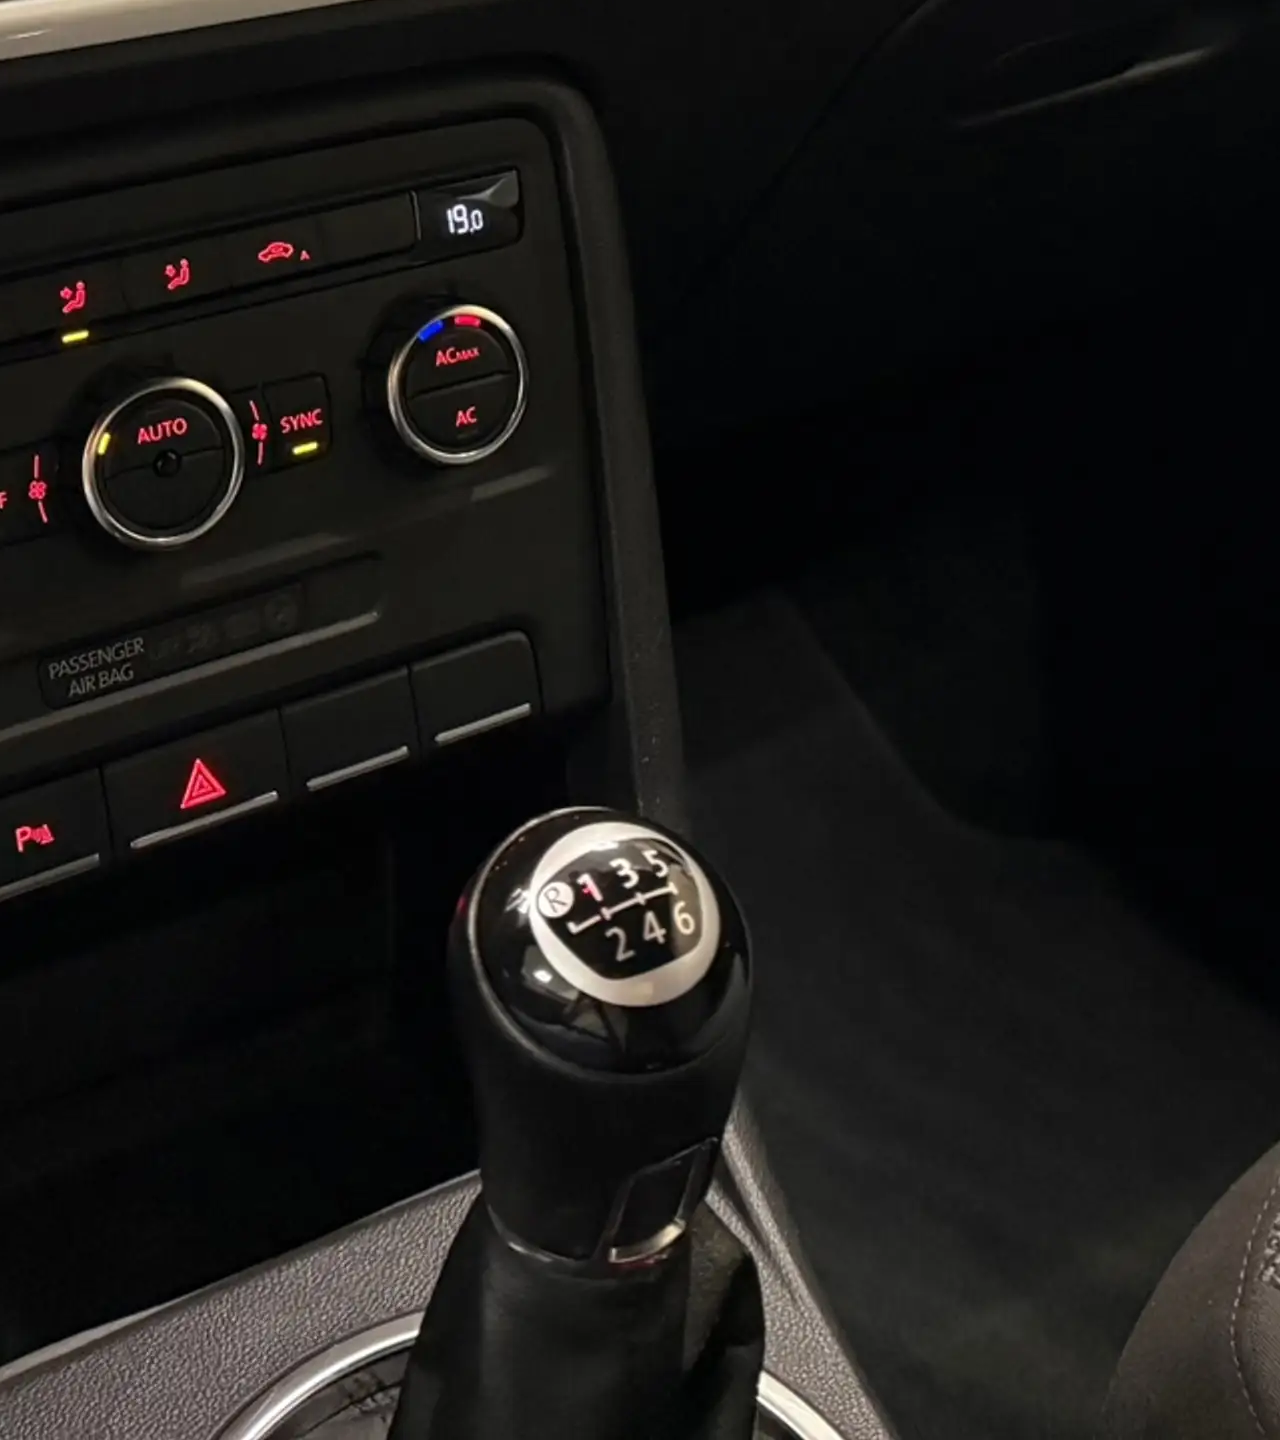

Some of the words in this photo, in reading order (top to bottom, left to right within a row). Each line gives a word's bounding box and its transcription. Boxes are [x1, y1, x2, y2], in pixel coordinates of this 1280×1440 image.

[446, 203, 484, 234] 19.0
[136, 417, 189, 445] AUTO
[280, 408, 324, 434] SYNC
[455, 406, 477, 428] AC
[48, 637, 145, 679] PASSENGER
[68, 674, 97, 698] AIR
[100, 662, 134, 689] BAG
[544, 885, 567, 914] R
[577, 873, 603, 903] 1
[609, 858, 640, 890] 3
[642, 849, 669, 878] 5
[605, 927, 636, 961] 2
[642, 911, 667, 945] 4
[673, 901, 696, 936] 6
